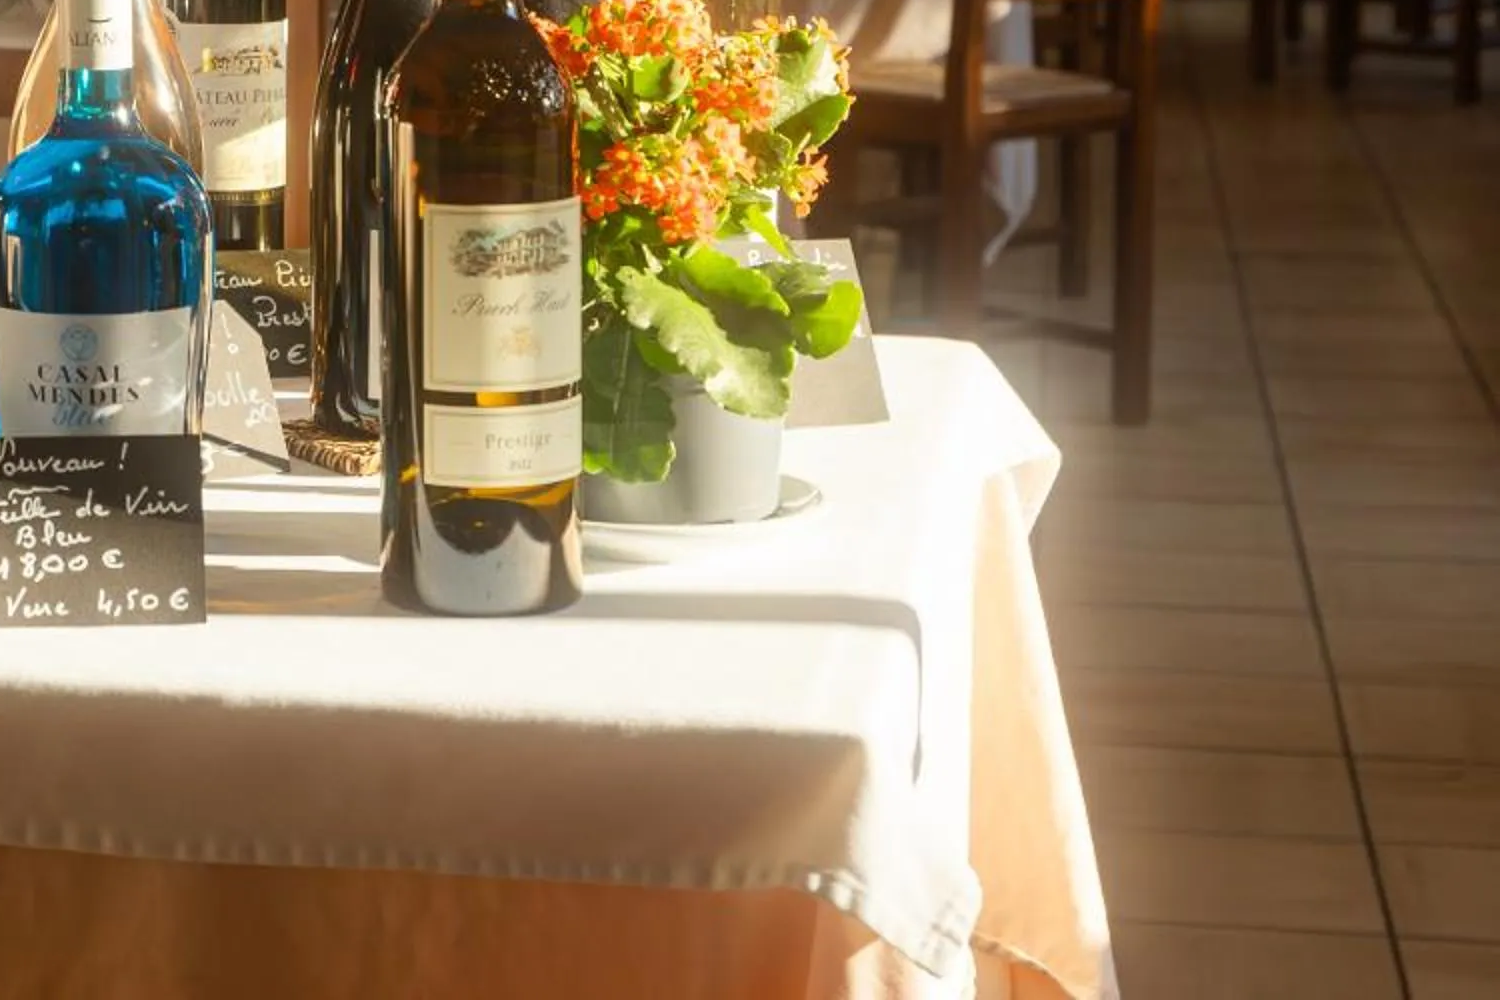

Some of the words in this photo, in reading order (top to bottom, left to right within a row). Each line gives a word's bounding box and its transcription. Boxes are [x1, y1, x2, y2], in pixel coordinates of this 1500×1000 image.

[28, 382, 141, 404] MENDES
[76, 489, 110, 518] de
[126, 486, 189, 517] Vin
[15, 524, 92, 549] Bleu
